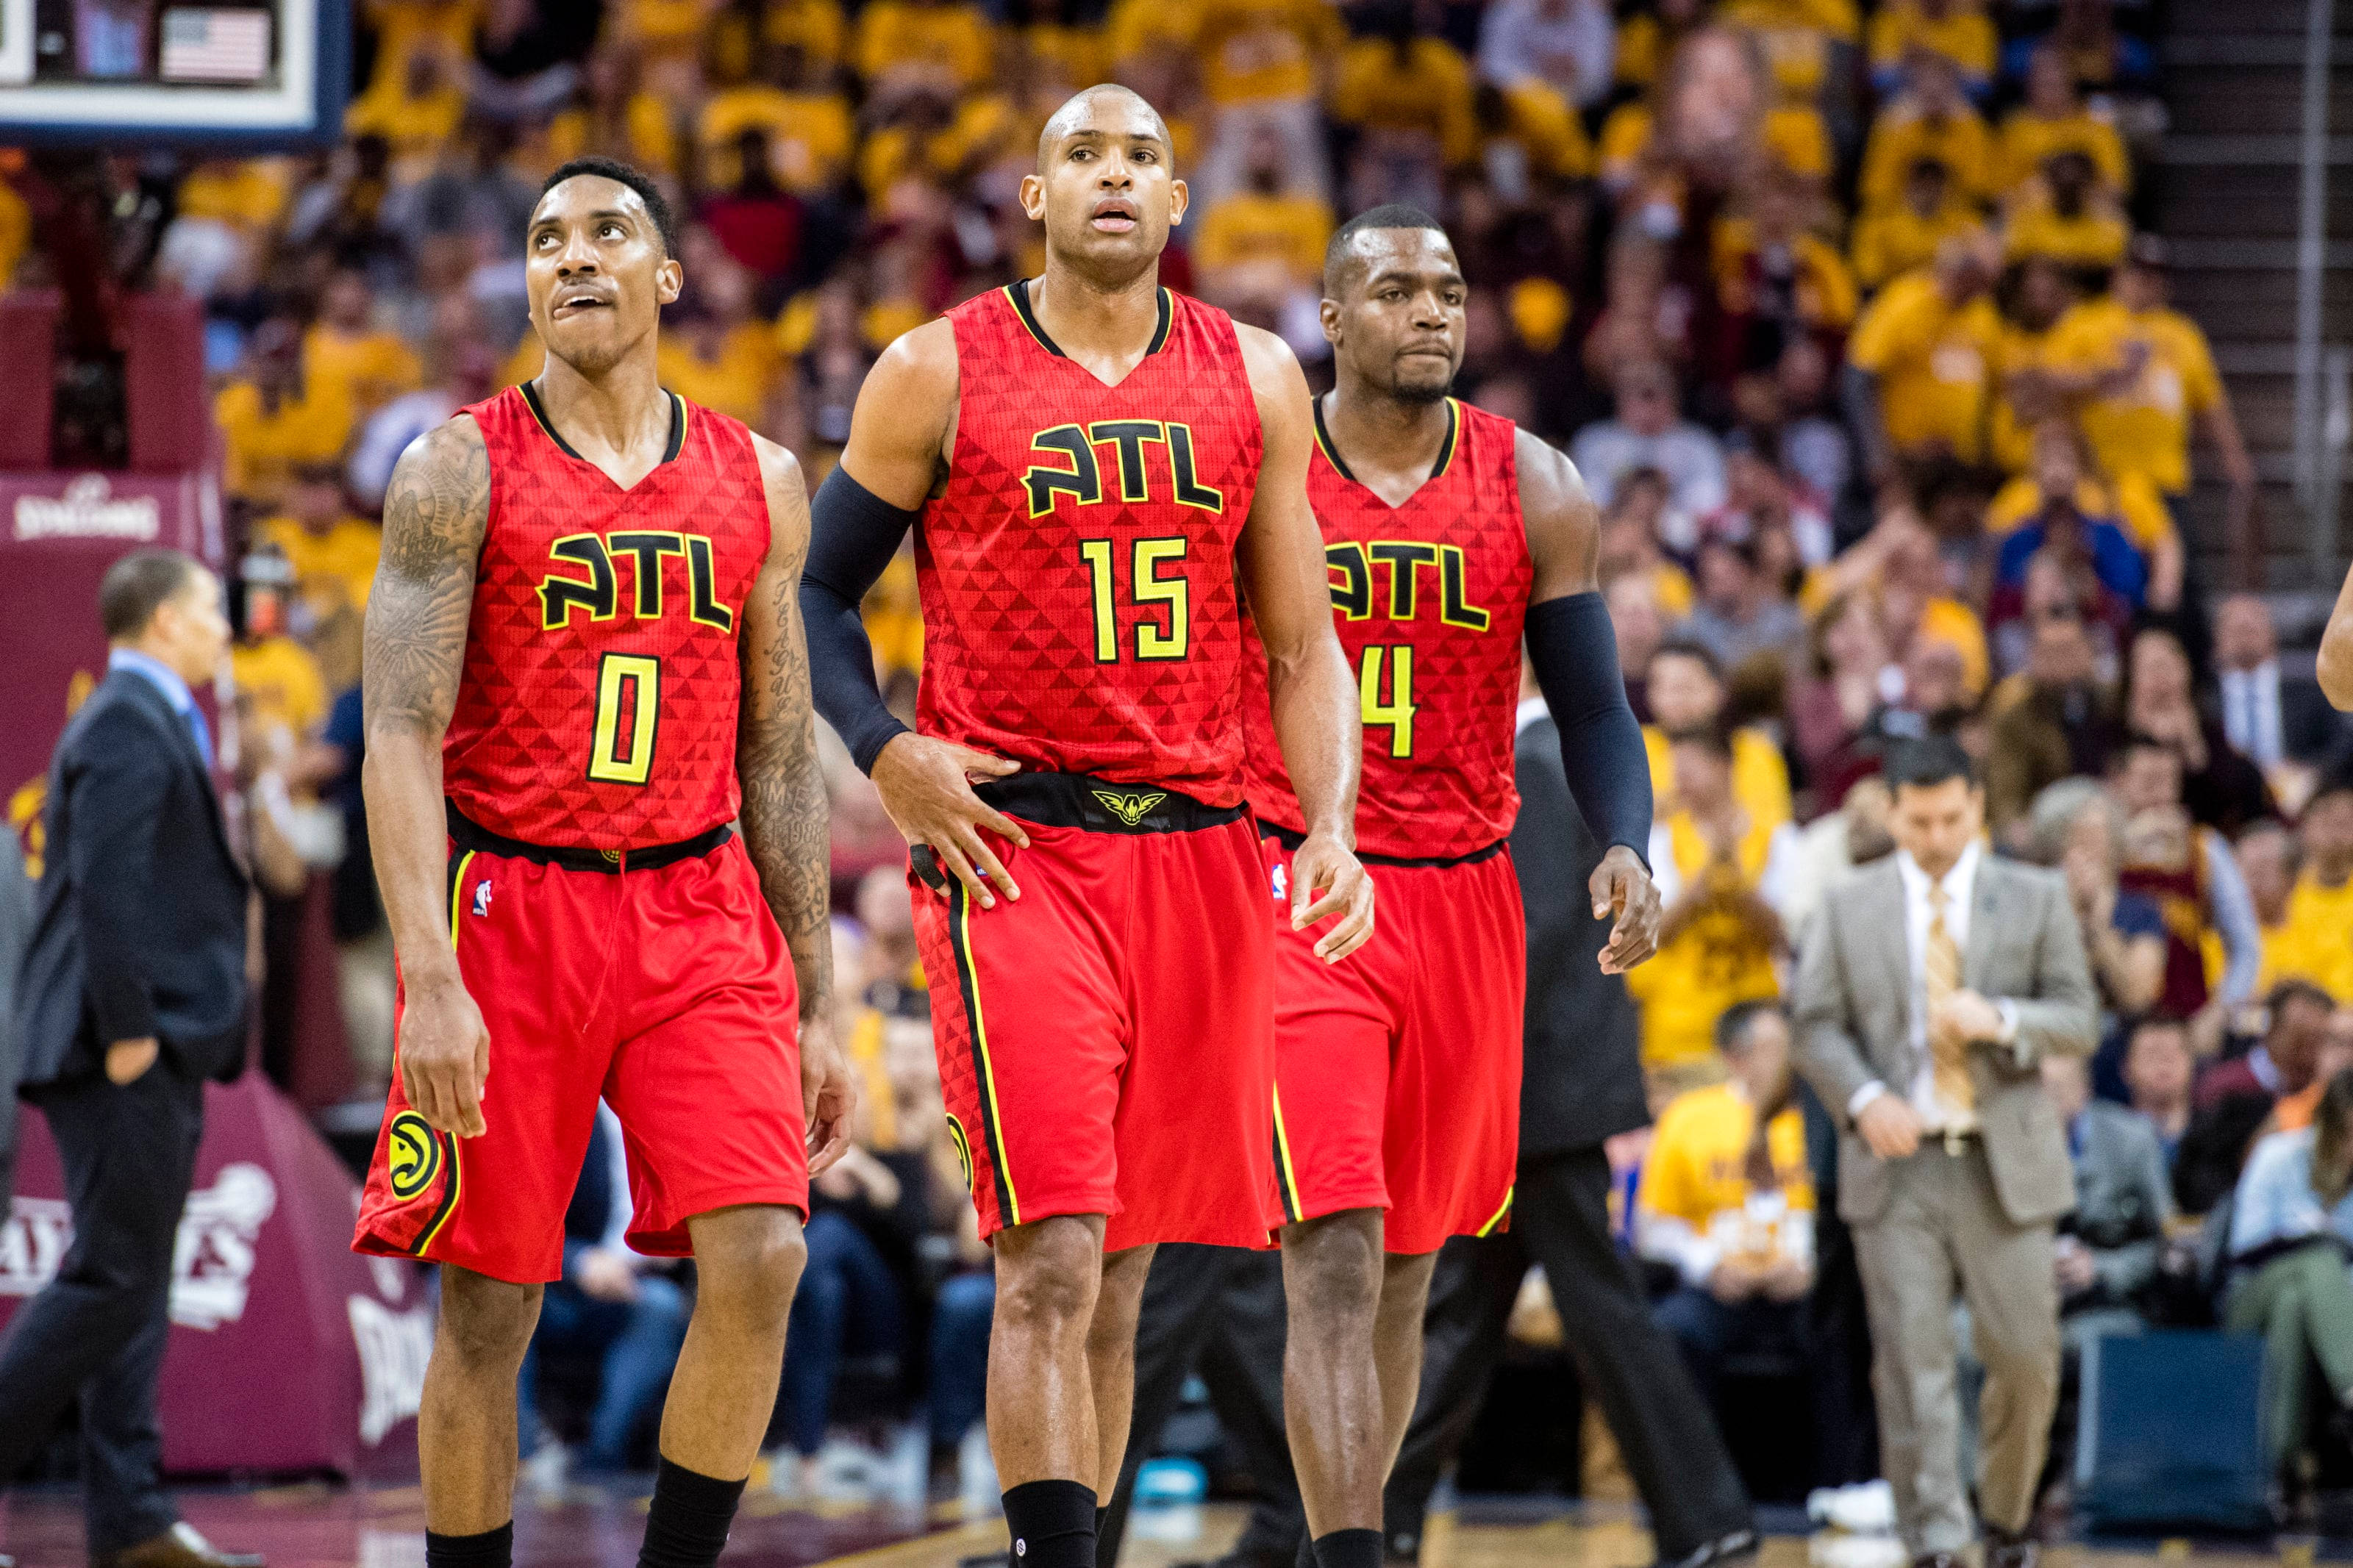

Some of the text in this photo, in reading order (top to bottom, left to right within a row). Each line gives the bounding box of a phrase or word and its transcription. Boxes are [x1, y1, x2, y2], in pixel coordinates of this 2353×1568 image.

[1020, 419, 1223, 519] ATL
[535, 530, 734, 634] ATL
[1078, 535, 1188, 665] 15
[1324, 540, 1490, 632] ATL
[585, 651, 661, 787] 0
[1360, 644, 1420, 759] 4
